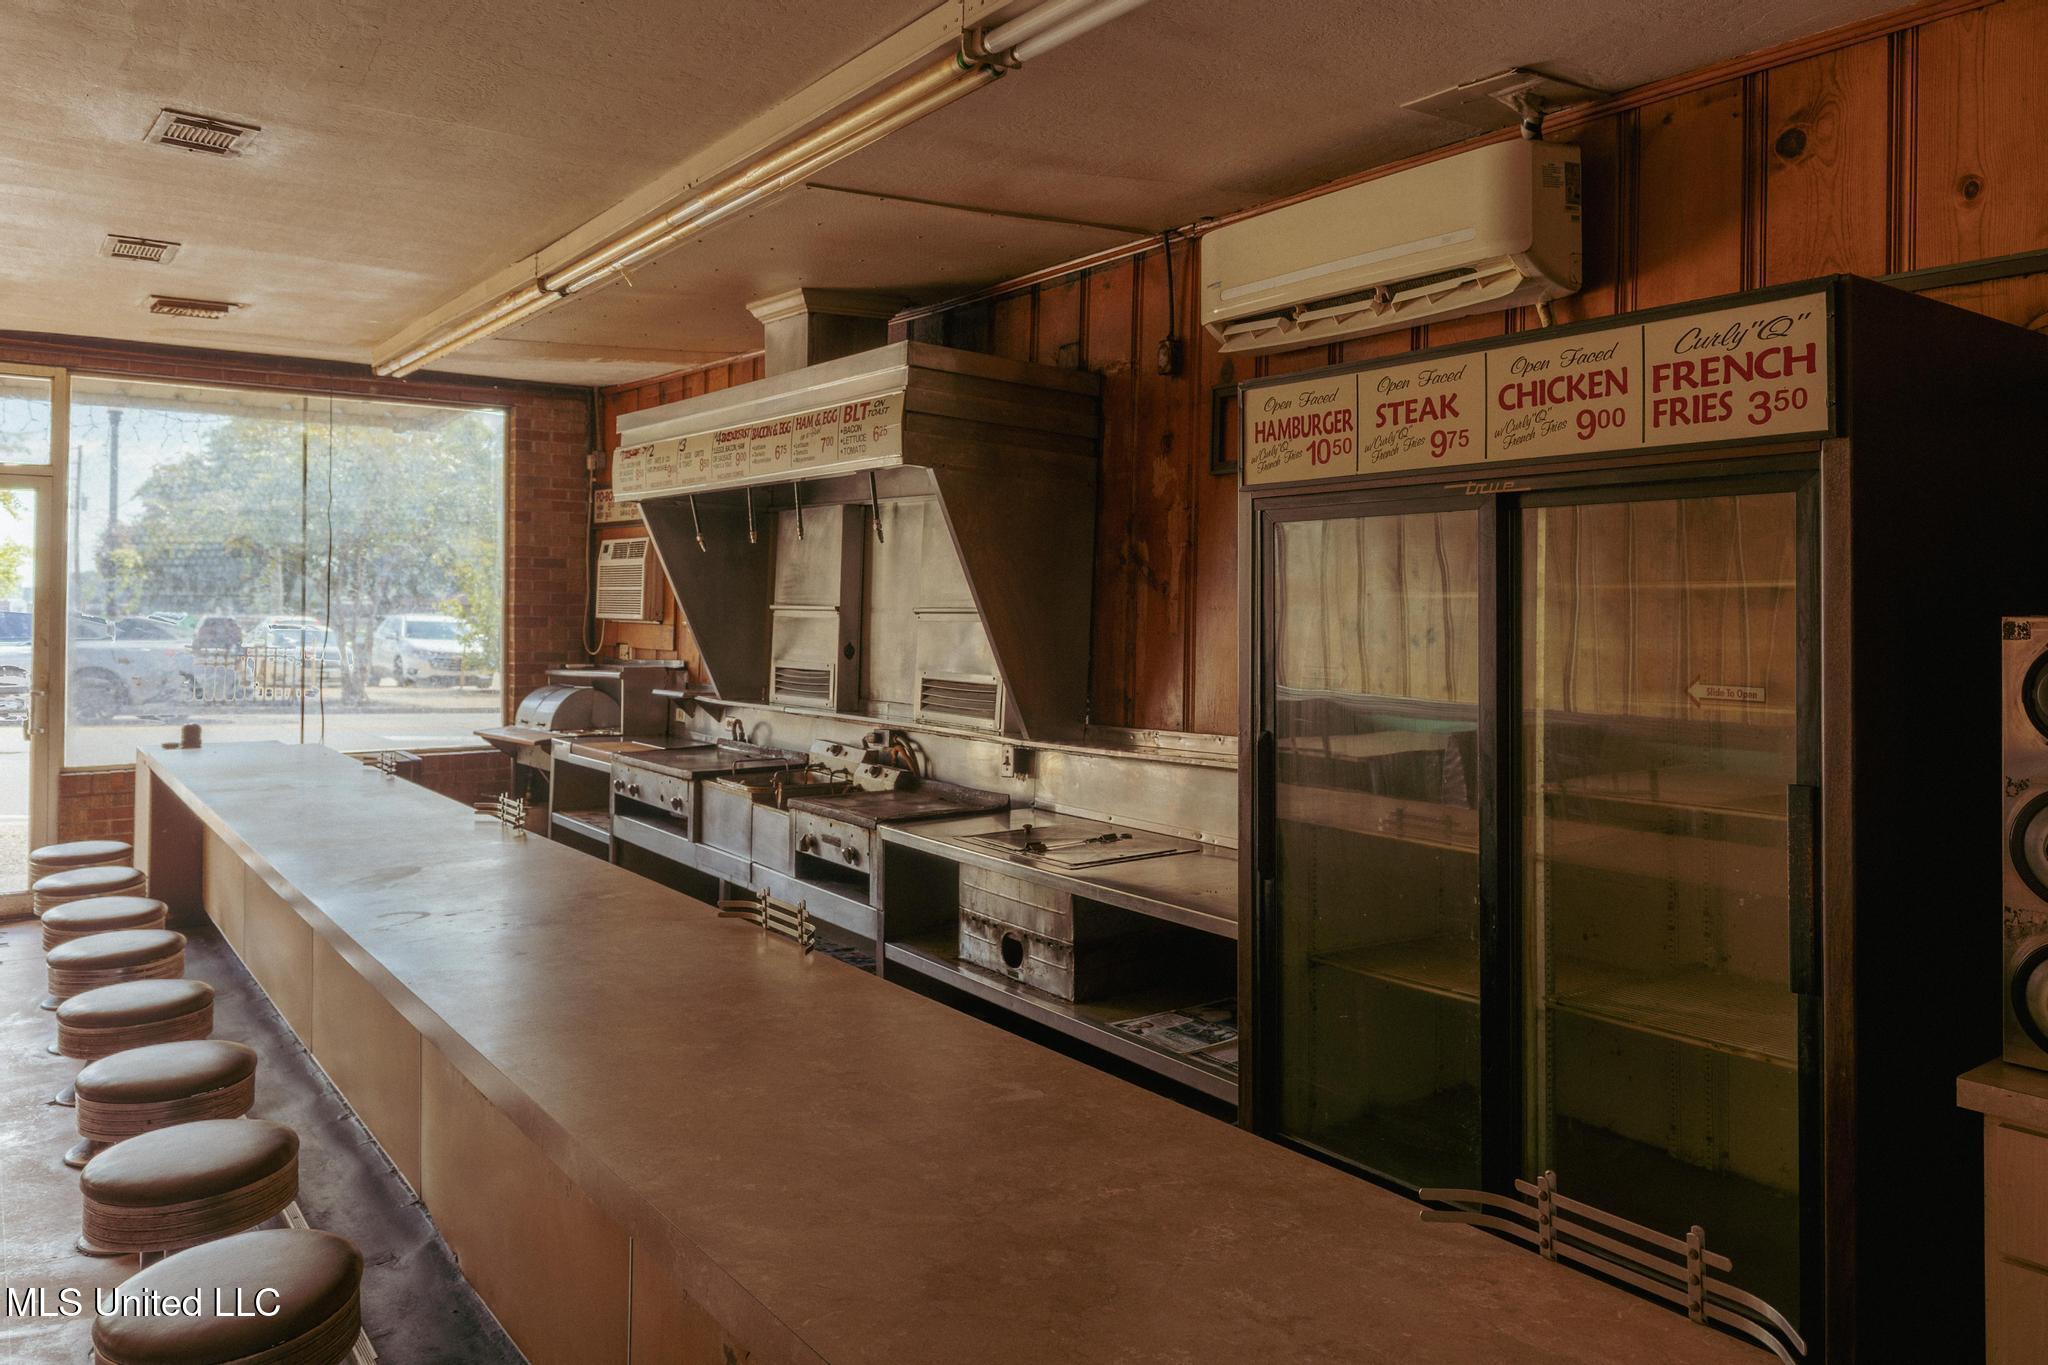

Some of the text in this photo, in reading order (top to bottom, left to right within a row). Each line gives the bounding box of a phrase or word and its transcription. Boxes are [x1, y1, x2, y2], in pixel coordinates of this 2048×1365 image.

[1674, 322, 1749, 354] Curly
[1510, 342, 1619, 377] Open Faced
[1652, 342, 1816, 393] FRENCH
[1376, 364, 1467, 396] Open Faced
[1498, 366, 1628, 411] CHICKEN
[843, 401, 871, 423] BLT
[868, 406, 890, 417] TOAST
[873, 399, 886, 408] ON
[1263, 387, 1340, 415] Open Faced
[1375, 392, 1460, 428] STEAK
[1653, 390, 1733, 428] FRIES
[751, 425, 773, 440] BACON
[779, 420, 791, 435] EGG
[795, 409, 838, 431] HAM & EGG
[1254, 408, 1354, 444] HAMBURGER
[1503, 420, 1567, 450] French Fries
[1257, 450, 1303, 474] French Fries
[1371, 436, 1425, 464] French Fries
[1727, 688, 1735, 698] To
[1737, 689, 1758, 699] Open
